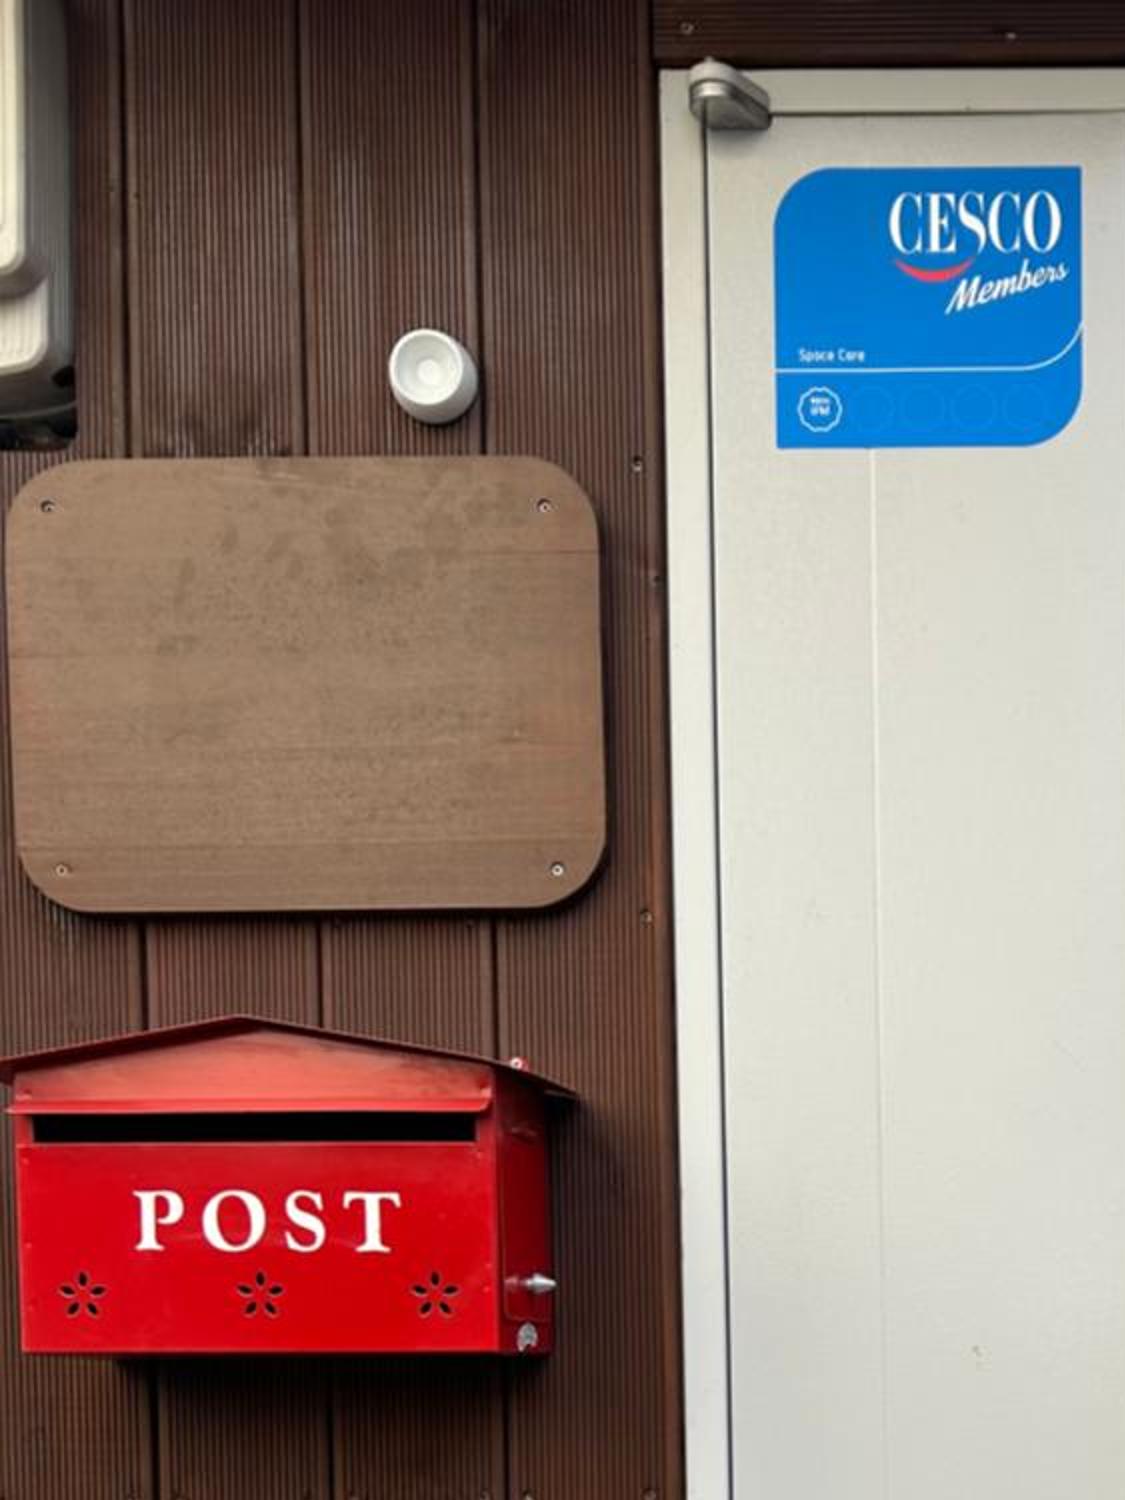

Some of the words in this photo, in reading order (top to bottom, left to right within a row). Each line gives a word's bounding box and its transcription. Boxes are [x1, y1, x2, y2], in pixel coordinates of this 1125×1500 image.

[889, 190, 1062, 254] CESCO
[944, 258, 1069, 315] Members
[799, 347, 833, 363] Space
[838, 348, 865, 362] Care
[132, 1189, 401, 1253] POST
